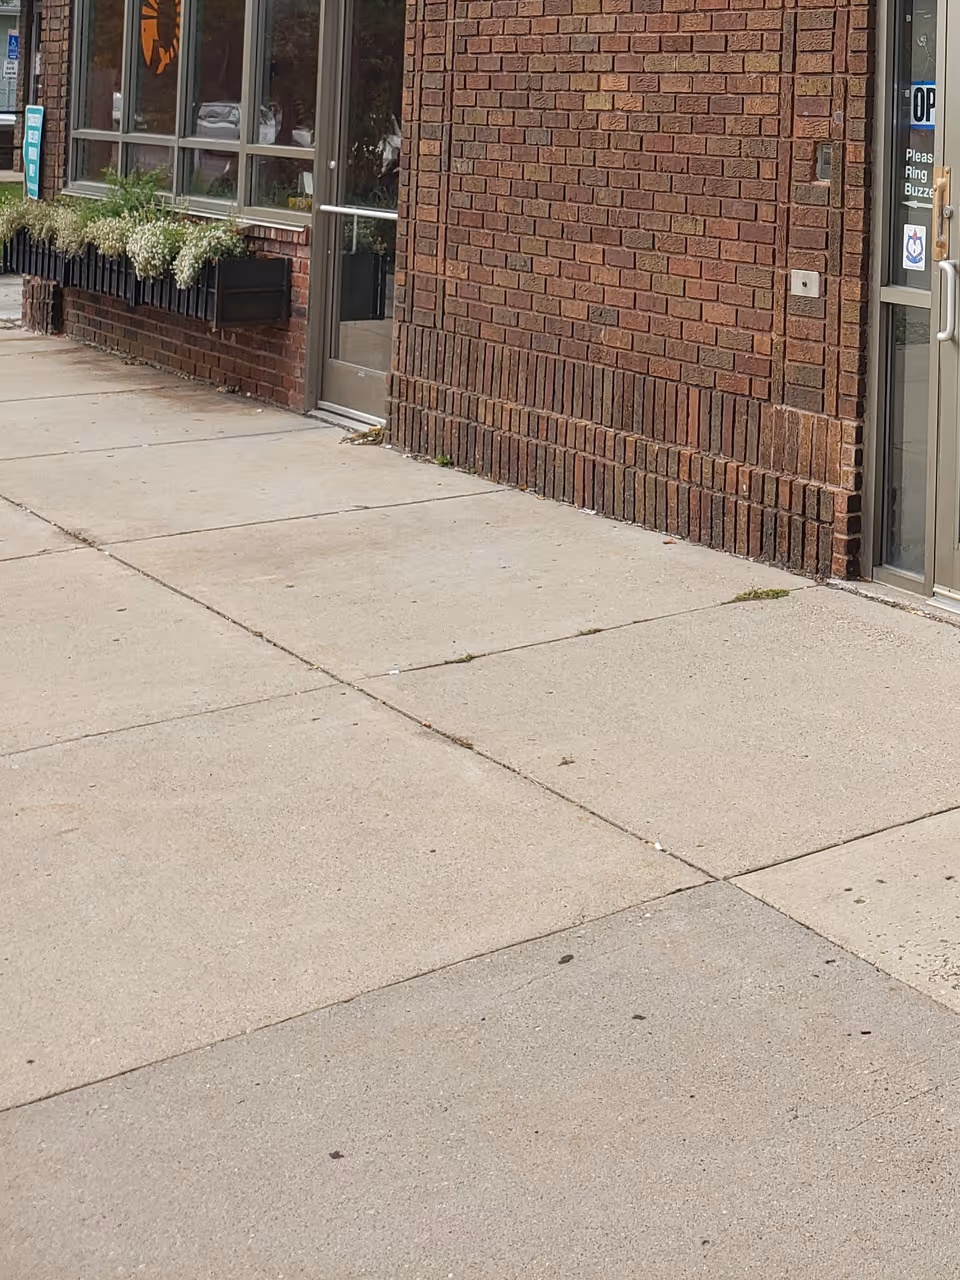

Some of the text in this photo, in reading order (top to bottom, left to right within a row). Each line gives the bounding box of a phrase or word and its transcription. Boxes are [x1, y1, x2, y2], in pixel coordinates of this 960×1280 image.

[913, 87, 936, 122] OP
[906, 148, 934, 164] Pleas
[905, 165, 928, 183] Ring
[904, 182, 934, 198] Buzze
